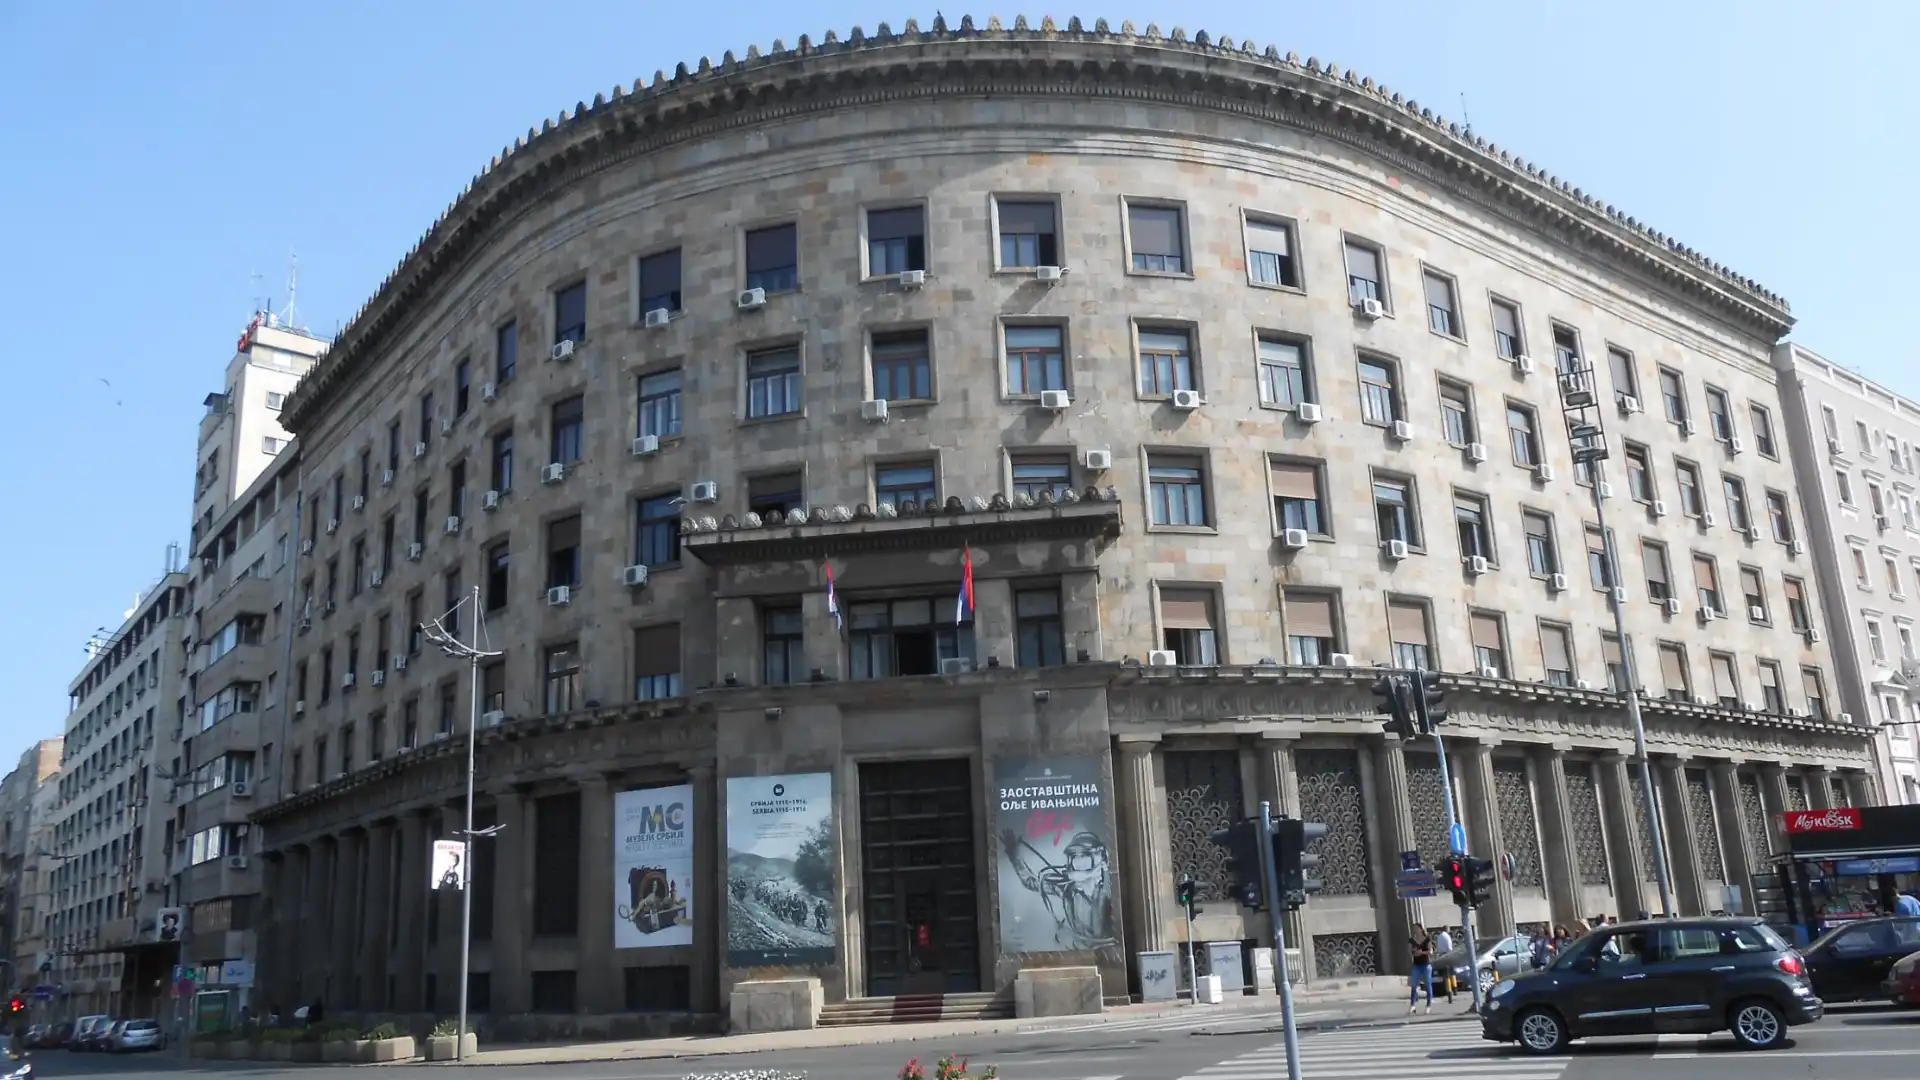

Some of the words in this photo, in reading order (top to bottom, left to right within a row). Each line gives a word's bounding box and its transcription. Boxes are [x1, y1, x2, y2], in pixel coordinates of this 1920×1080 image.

[1000, 784, 1098, 798] ЗАОСТАВШТИНА
[1001, 801, 1027, 810] ОЉЕ
[1031, 797, 1099, 809] ИВАЊИЦКИ
[639, 802, 684, 834] МС
[626, 834, 655, 843] МУЗЕЈИ
[656, 831, 684, 841] СРБИЈЕ
